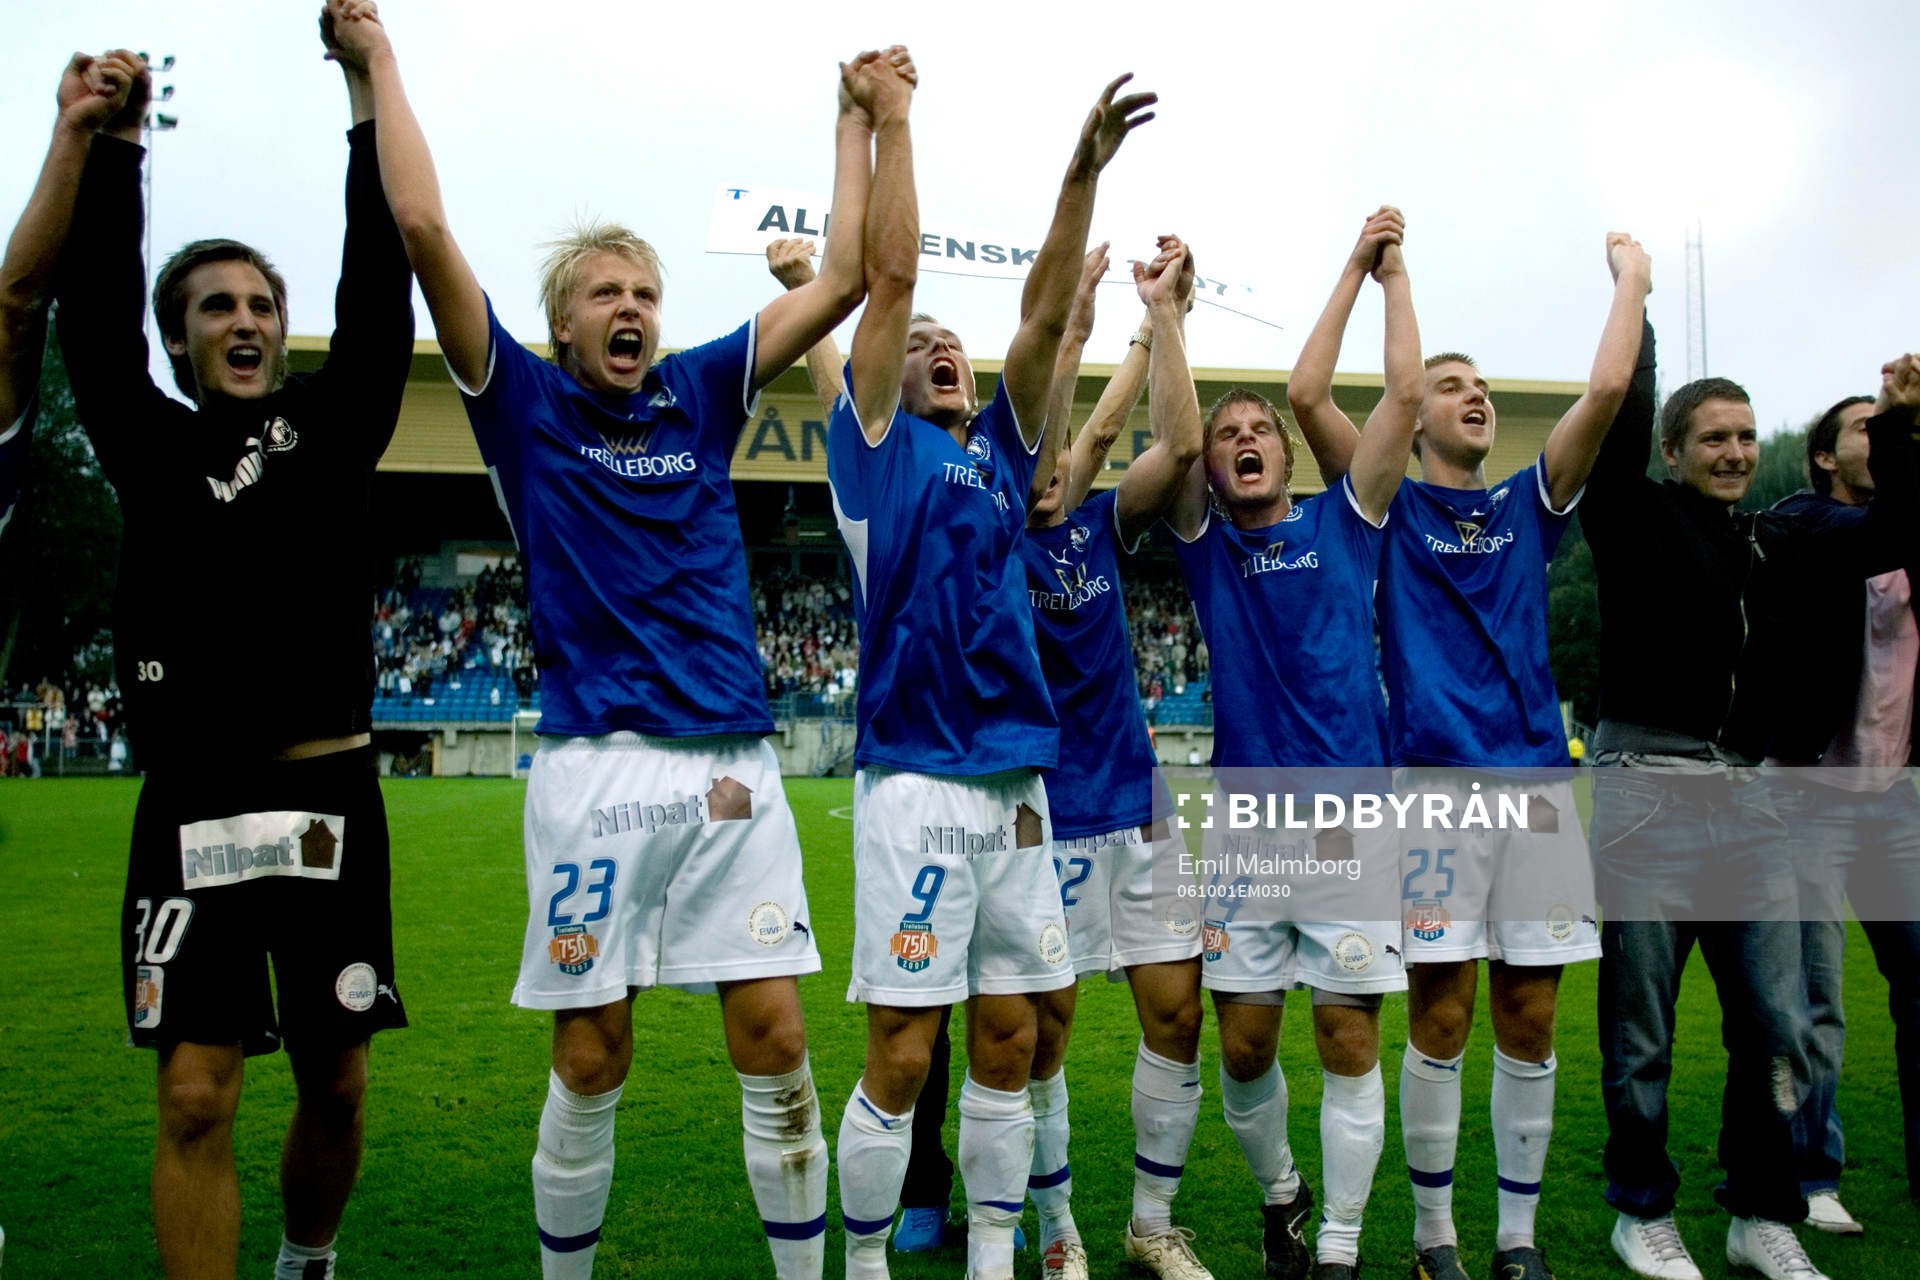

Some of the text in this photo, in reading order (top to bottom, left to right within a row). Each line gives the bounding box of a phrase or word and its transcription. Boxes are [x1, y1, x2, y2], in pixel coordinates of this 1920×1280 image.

[138, 660, 164, 682] 30
[590, 794, 704, 838] Nilpat
[185, 835, 295, 879] Nilpat
[920, 825, 1007, 860] Nilpat
[547, 858, 617, 926] 23
[902, 865, 946, 922] 9
[1402, 848, 1457, 900] 25
